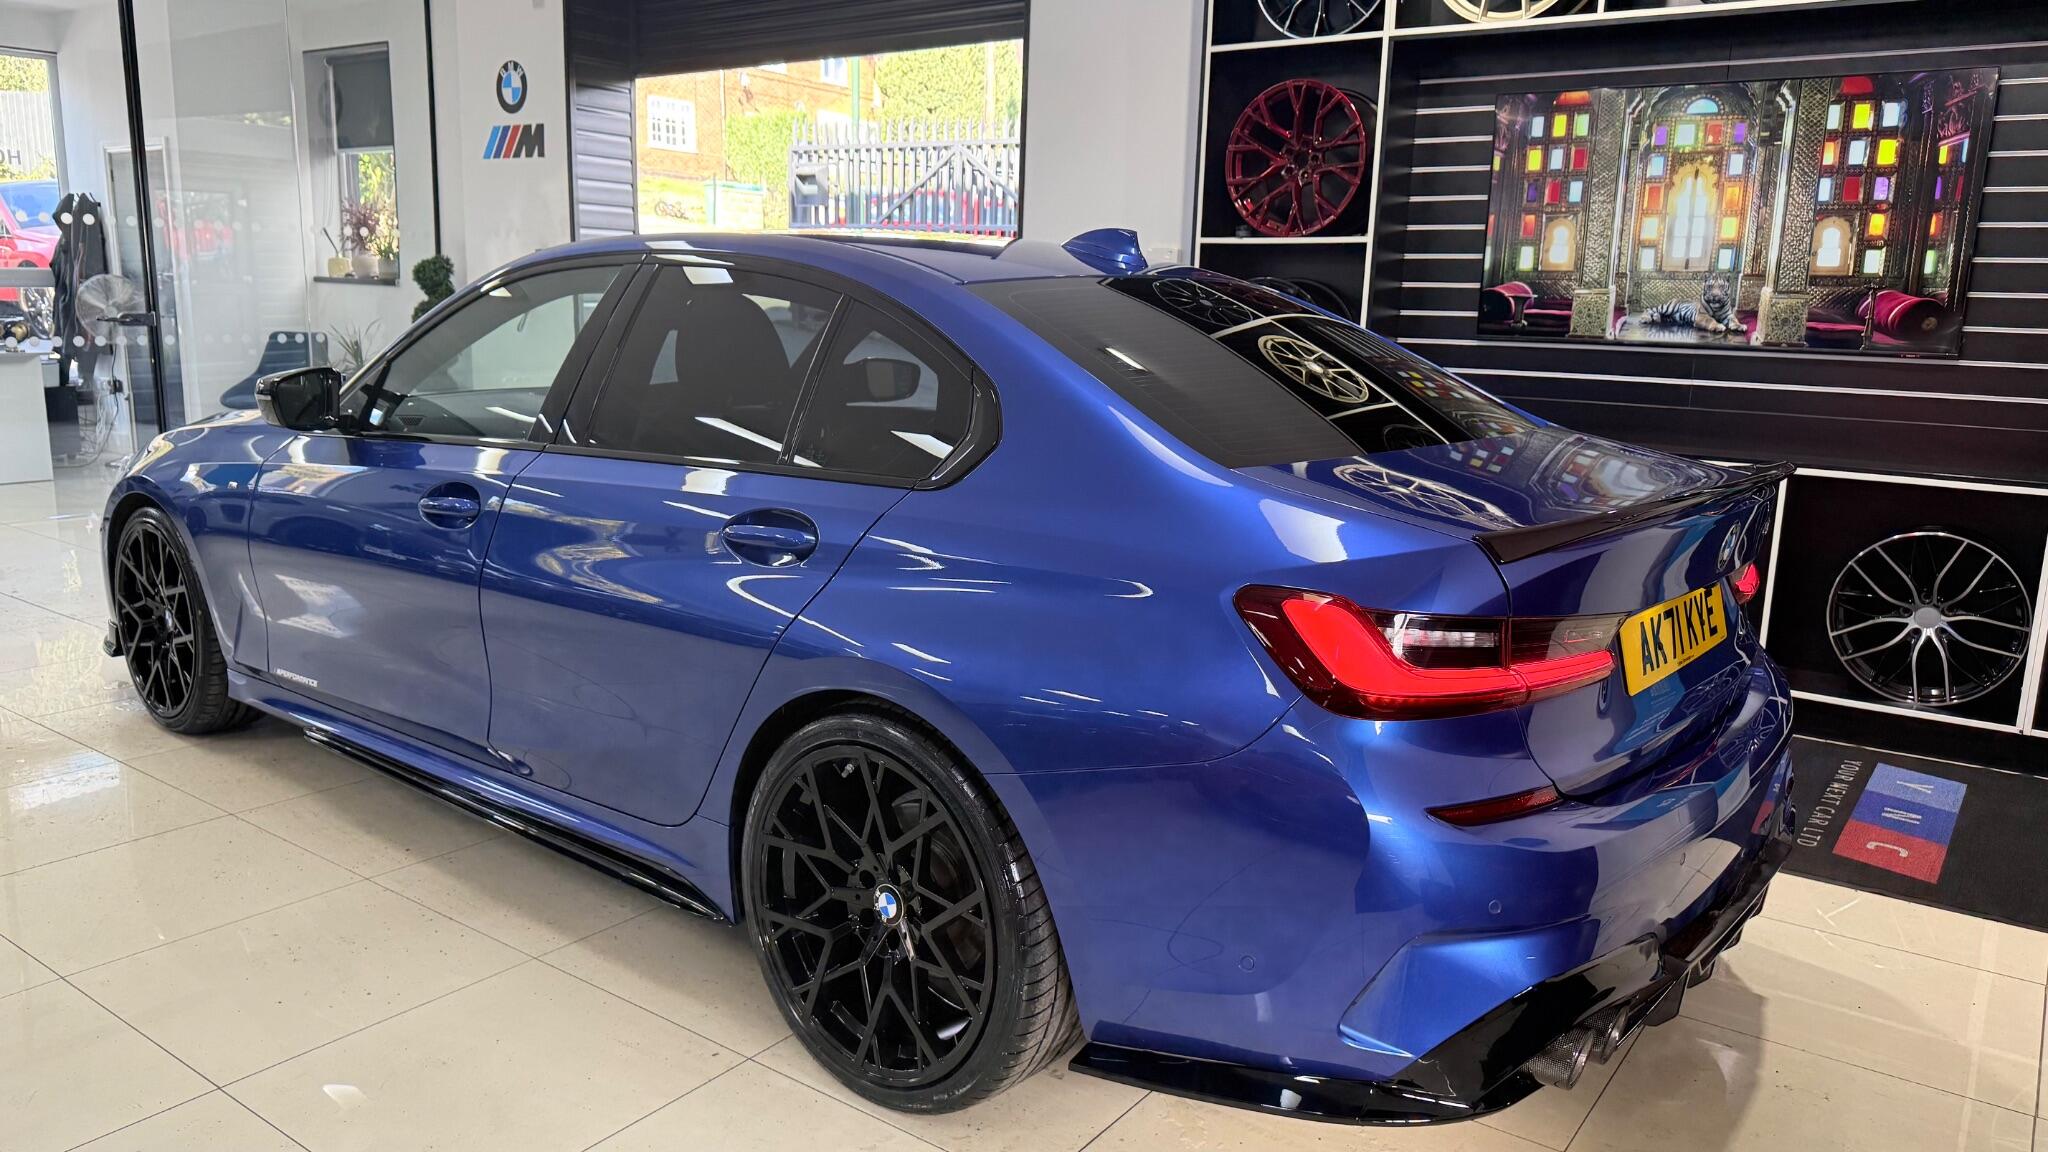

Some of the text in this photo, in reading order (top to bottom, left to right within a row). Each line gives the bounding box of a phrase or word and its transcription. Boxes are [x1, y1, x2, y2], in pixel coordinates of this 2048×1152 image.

[1640, 589, 1718, 676] AK71 KYE
[1797, 760, 1863, 847] YOUR NEXT CAR LTD
